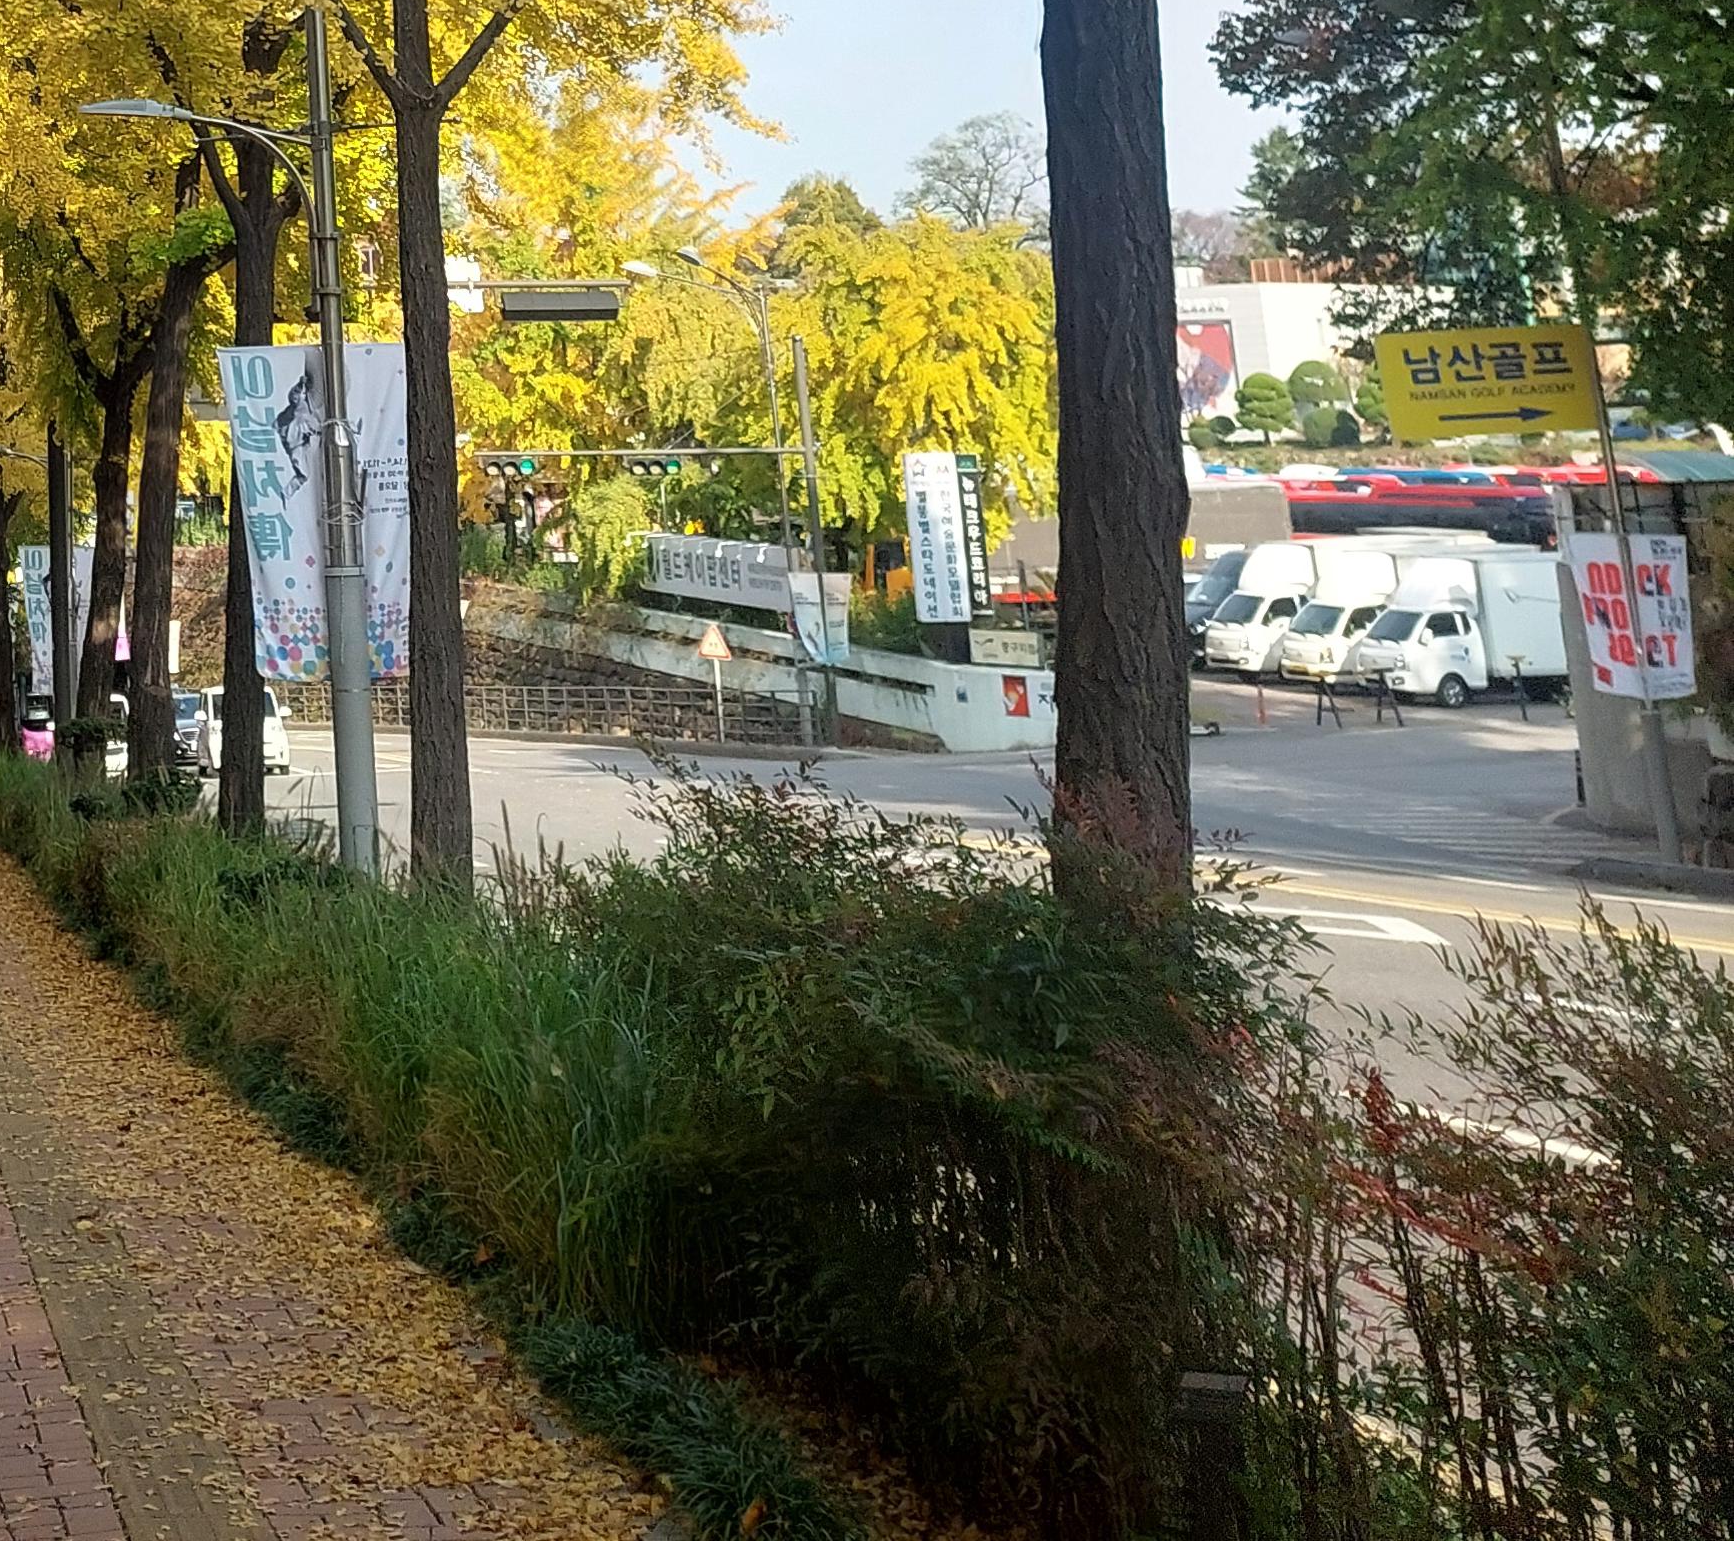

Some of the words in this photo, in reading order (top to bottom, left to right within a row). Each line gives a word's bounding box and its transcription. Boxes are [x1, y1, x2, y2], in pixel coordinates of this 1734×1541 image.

[1402, 341, 1573, 385] 남산골프
[1409, 389, 1466, 402] NAMSAN
[1471, 388, 1505, 399] GOLF
[1512, 383, 1576, 396] ACADEMY
[662, 548, 742, 591] 월드케이팝센터
